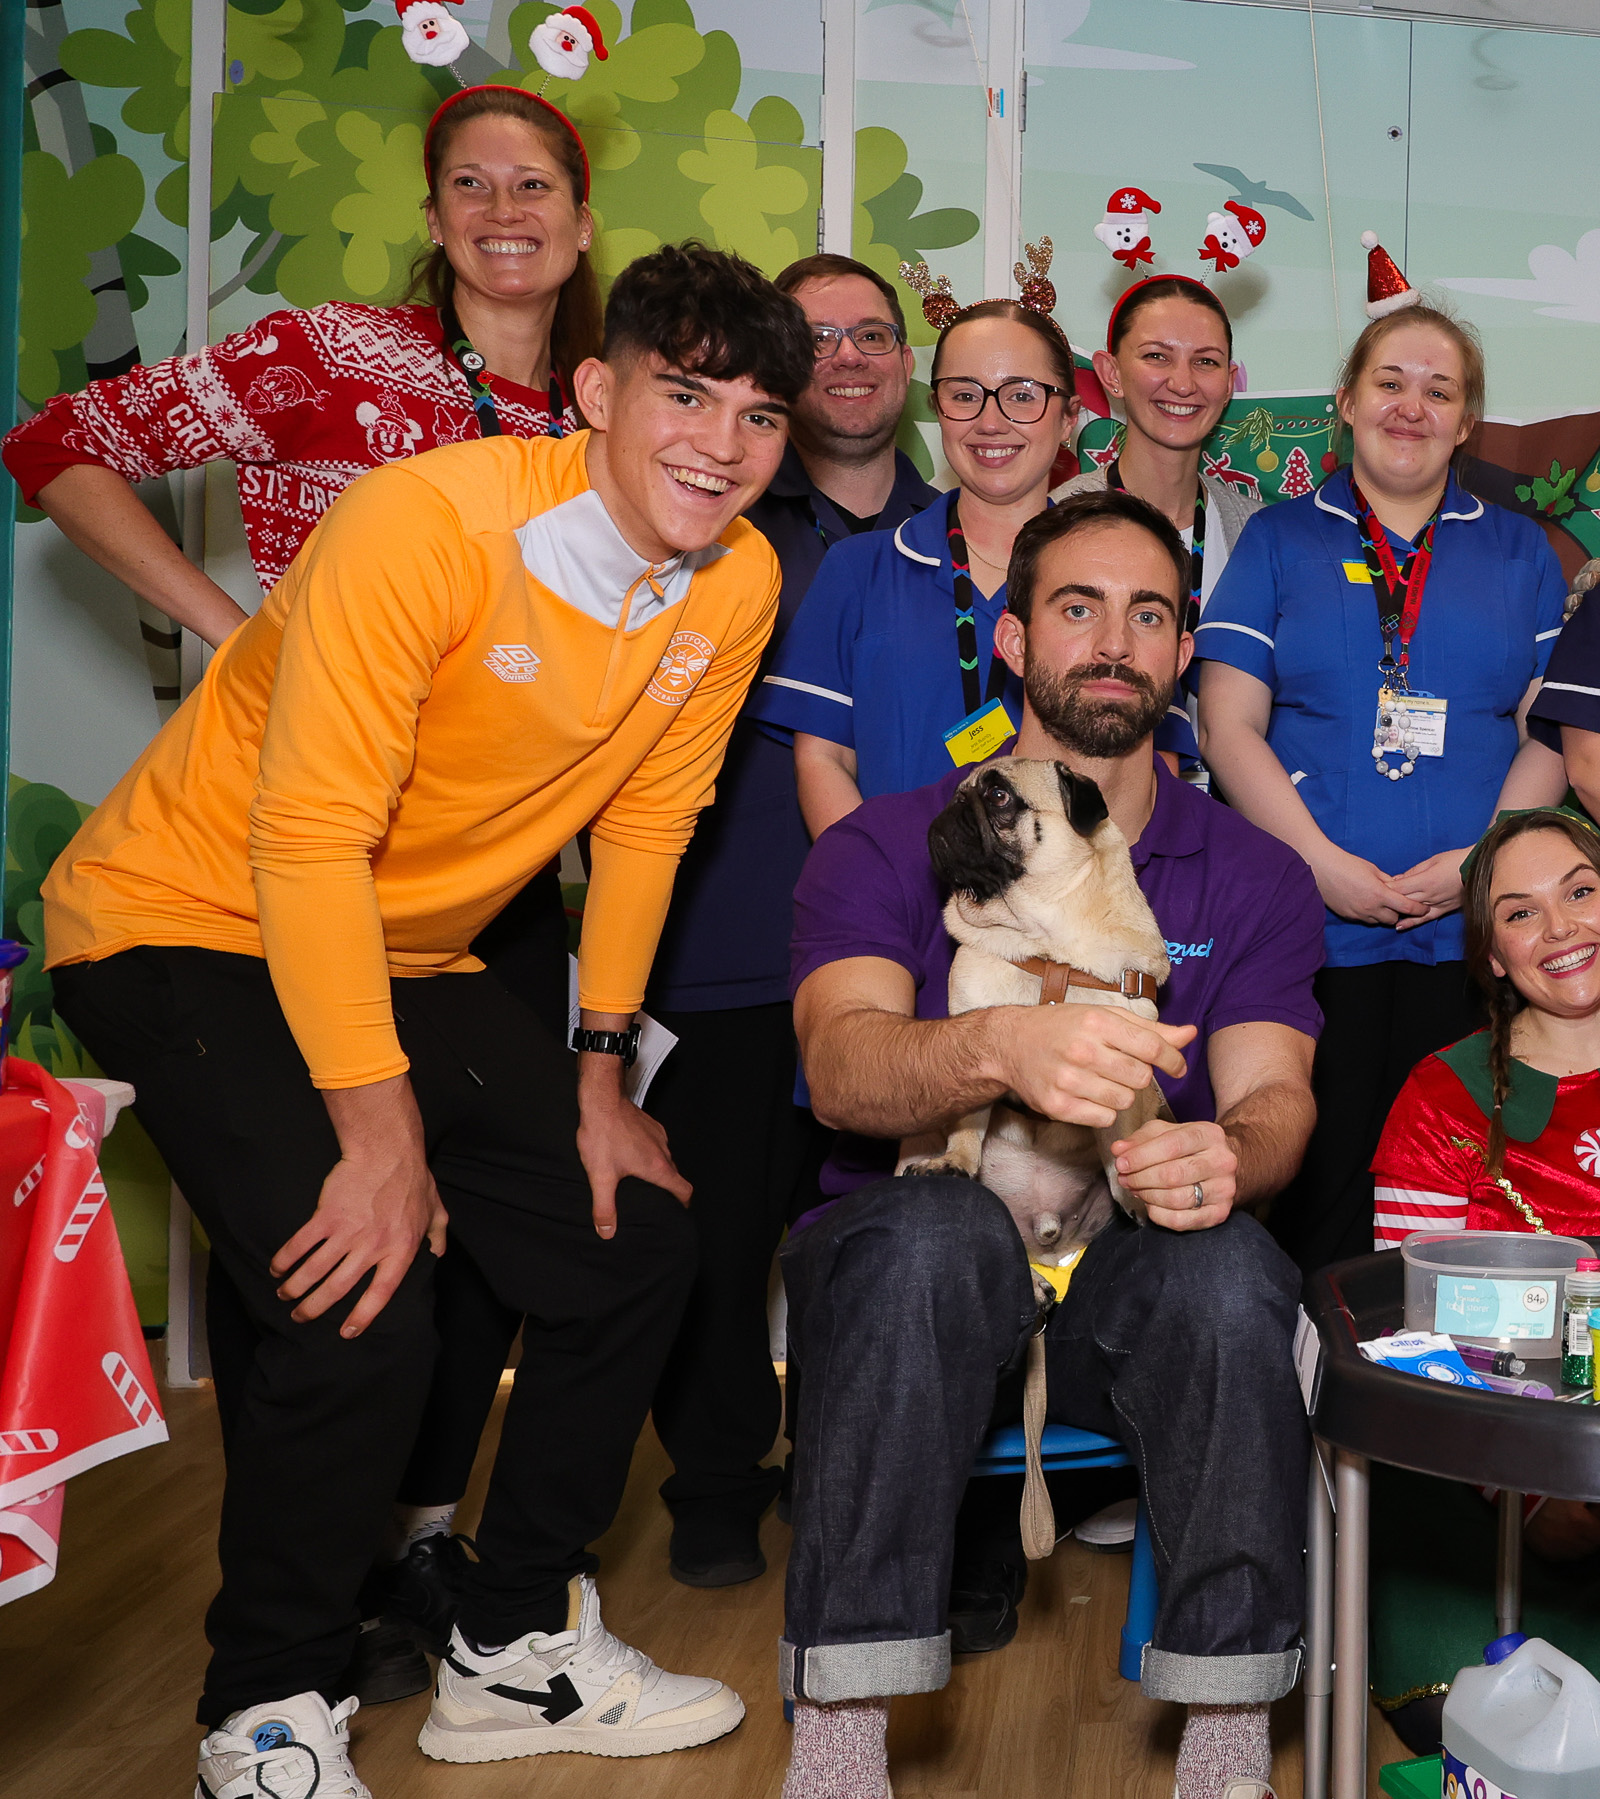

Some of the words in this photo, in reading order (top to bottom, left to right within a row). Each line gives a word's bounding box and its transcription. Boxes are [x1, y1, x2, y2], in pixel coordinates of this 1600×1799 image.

[488, 662, 532, 681] TRAINING
[647, 683, 681, 702] OOTBALL
[968, 725, 984, 740] Jess
[1526, 1293, 1546, 1305] 84p
